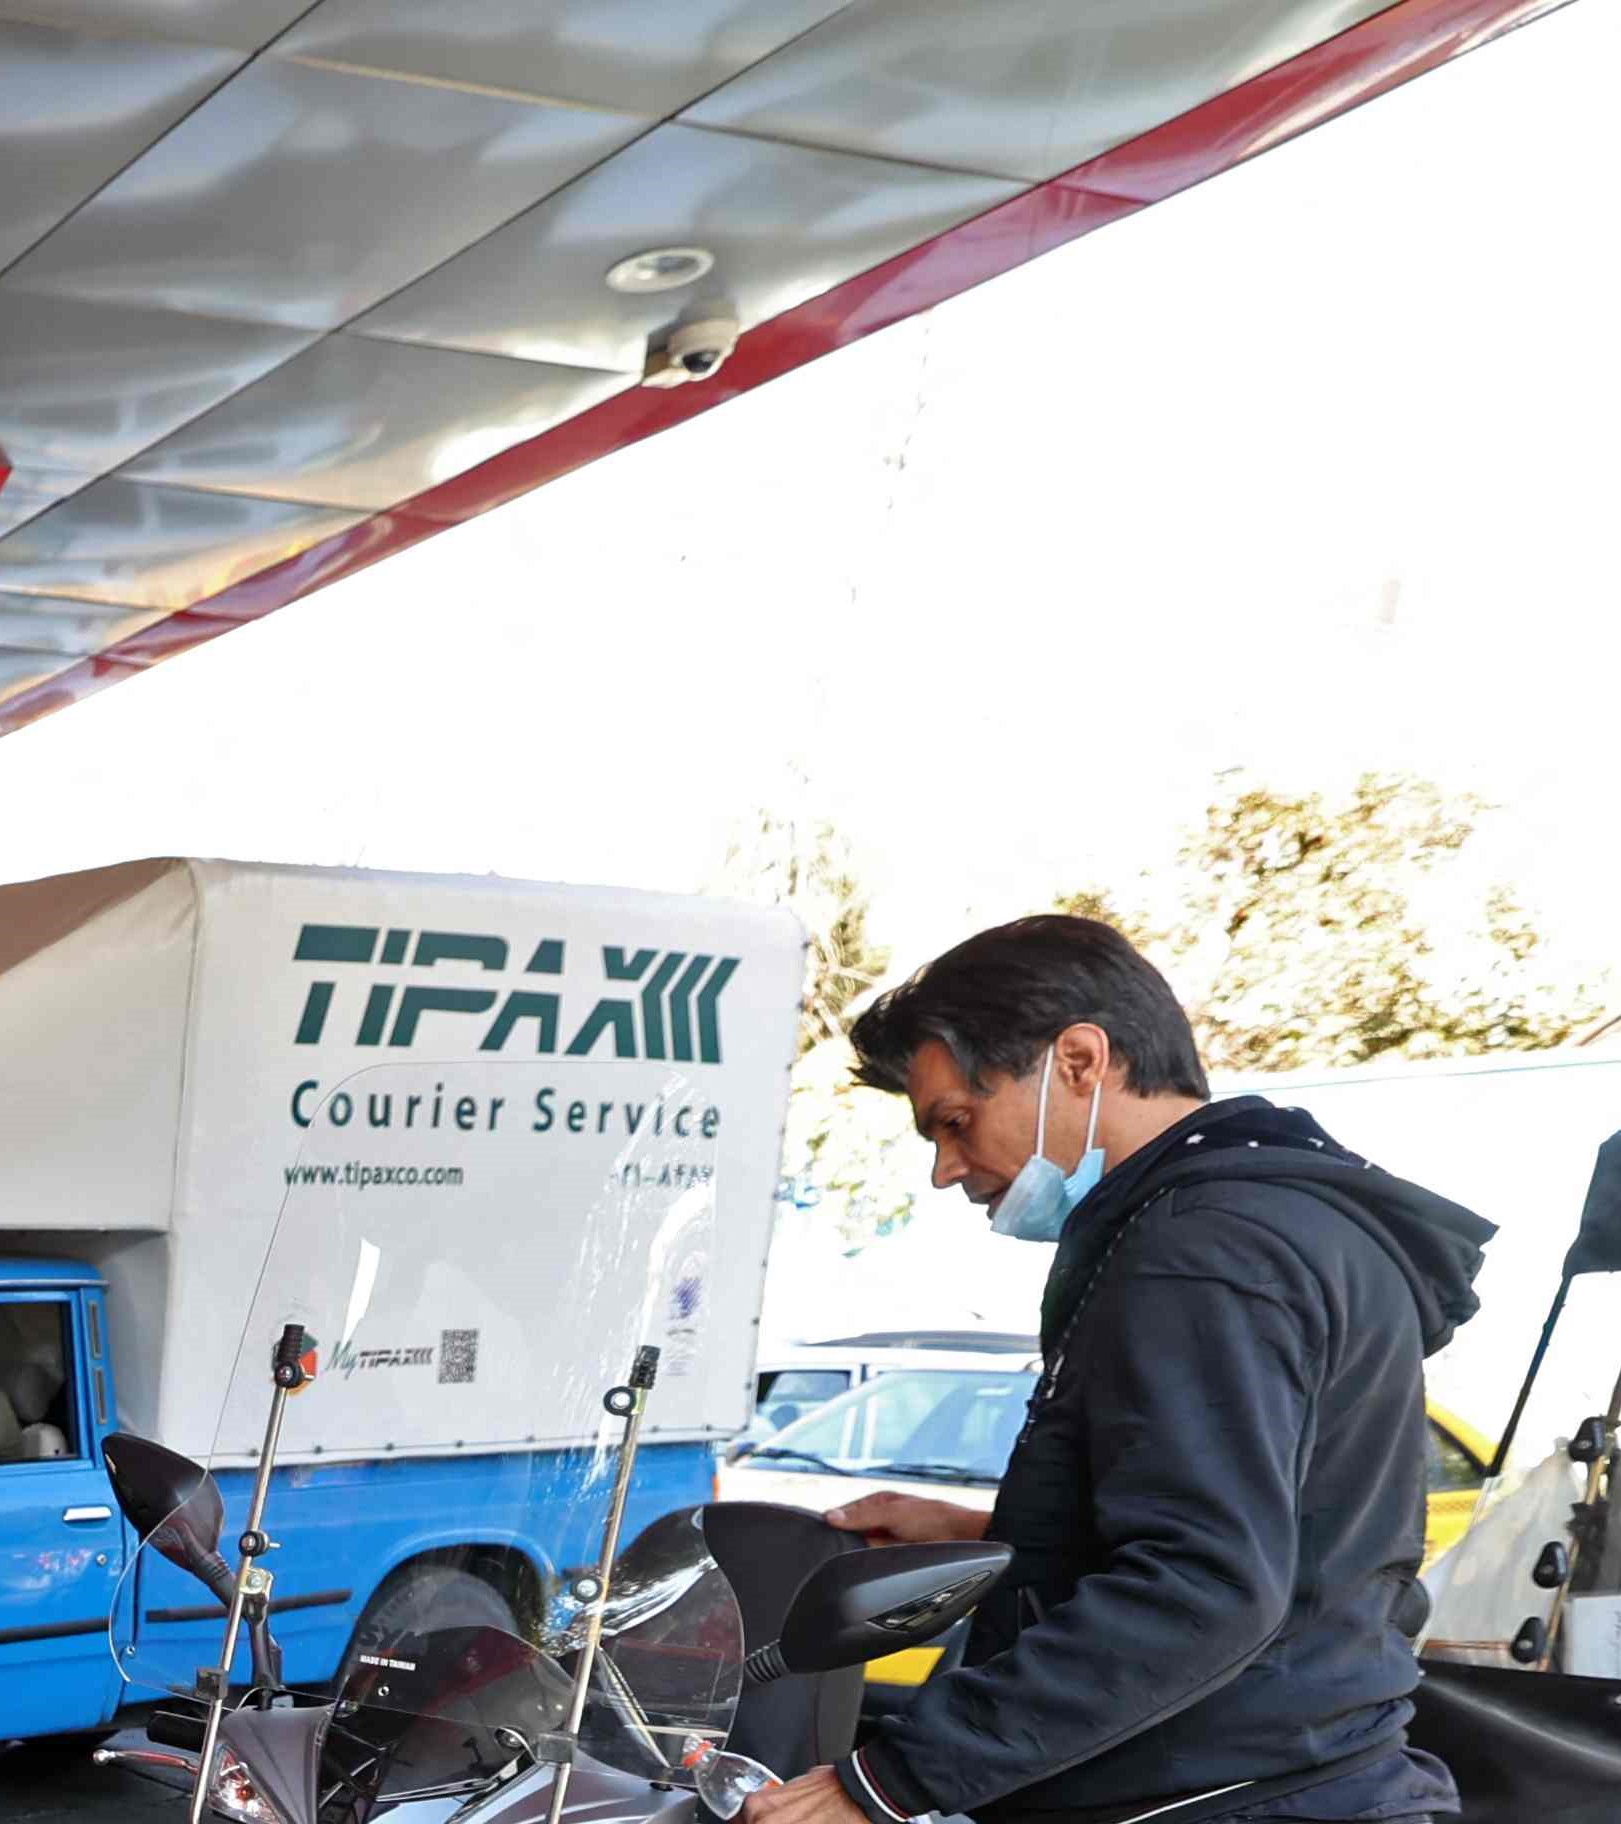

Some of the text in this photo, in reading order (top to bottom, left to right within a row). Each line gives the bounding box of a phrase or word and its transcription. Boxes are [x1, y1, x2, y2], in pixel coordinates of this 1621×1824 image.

[292, 924, 743, 1064] TIPAX
[291, 1080, 722, 1139] Courier Service
[284, 1160, 464, 1191] www.tipaxco.com
